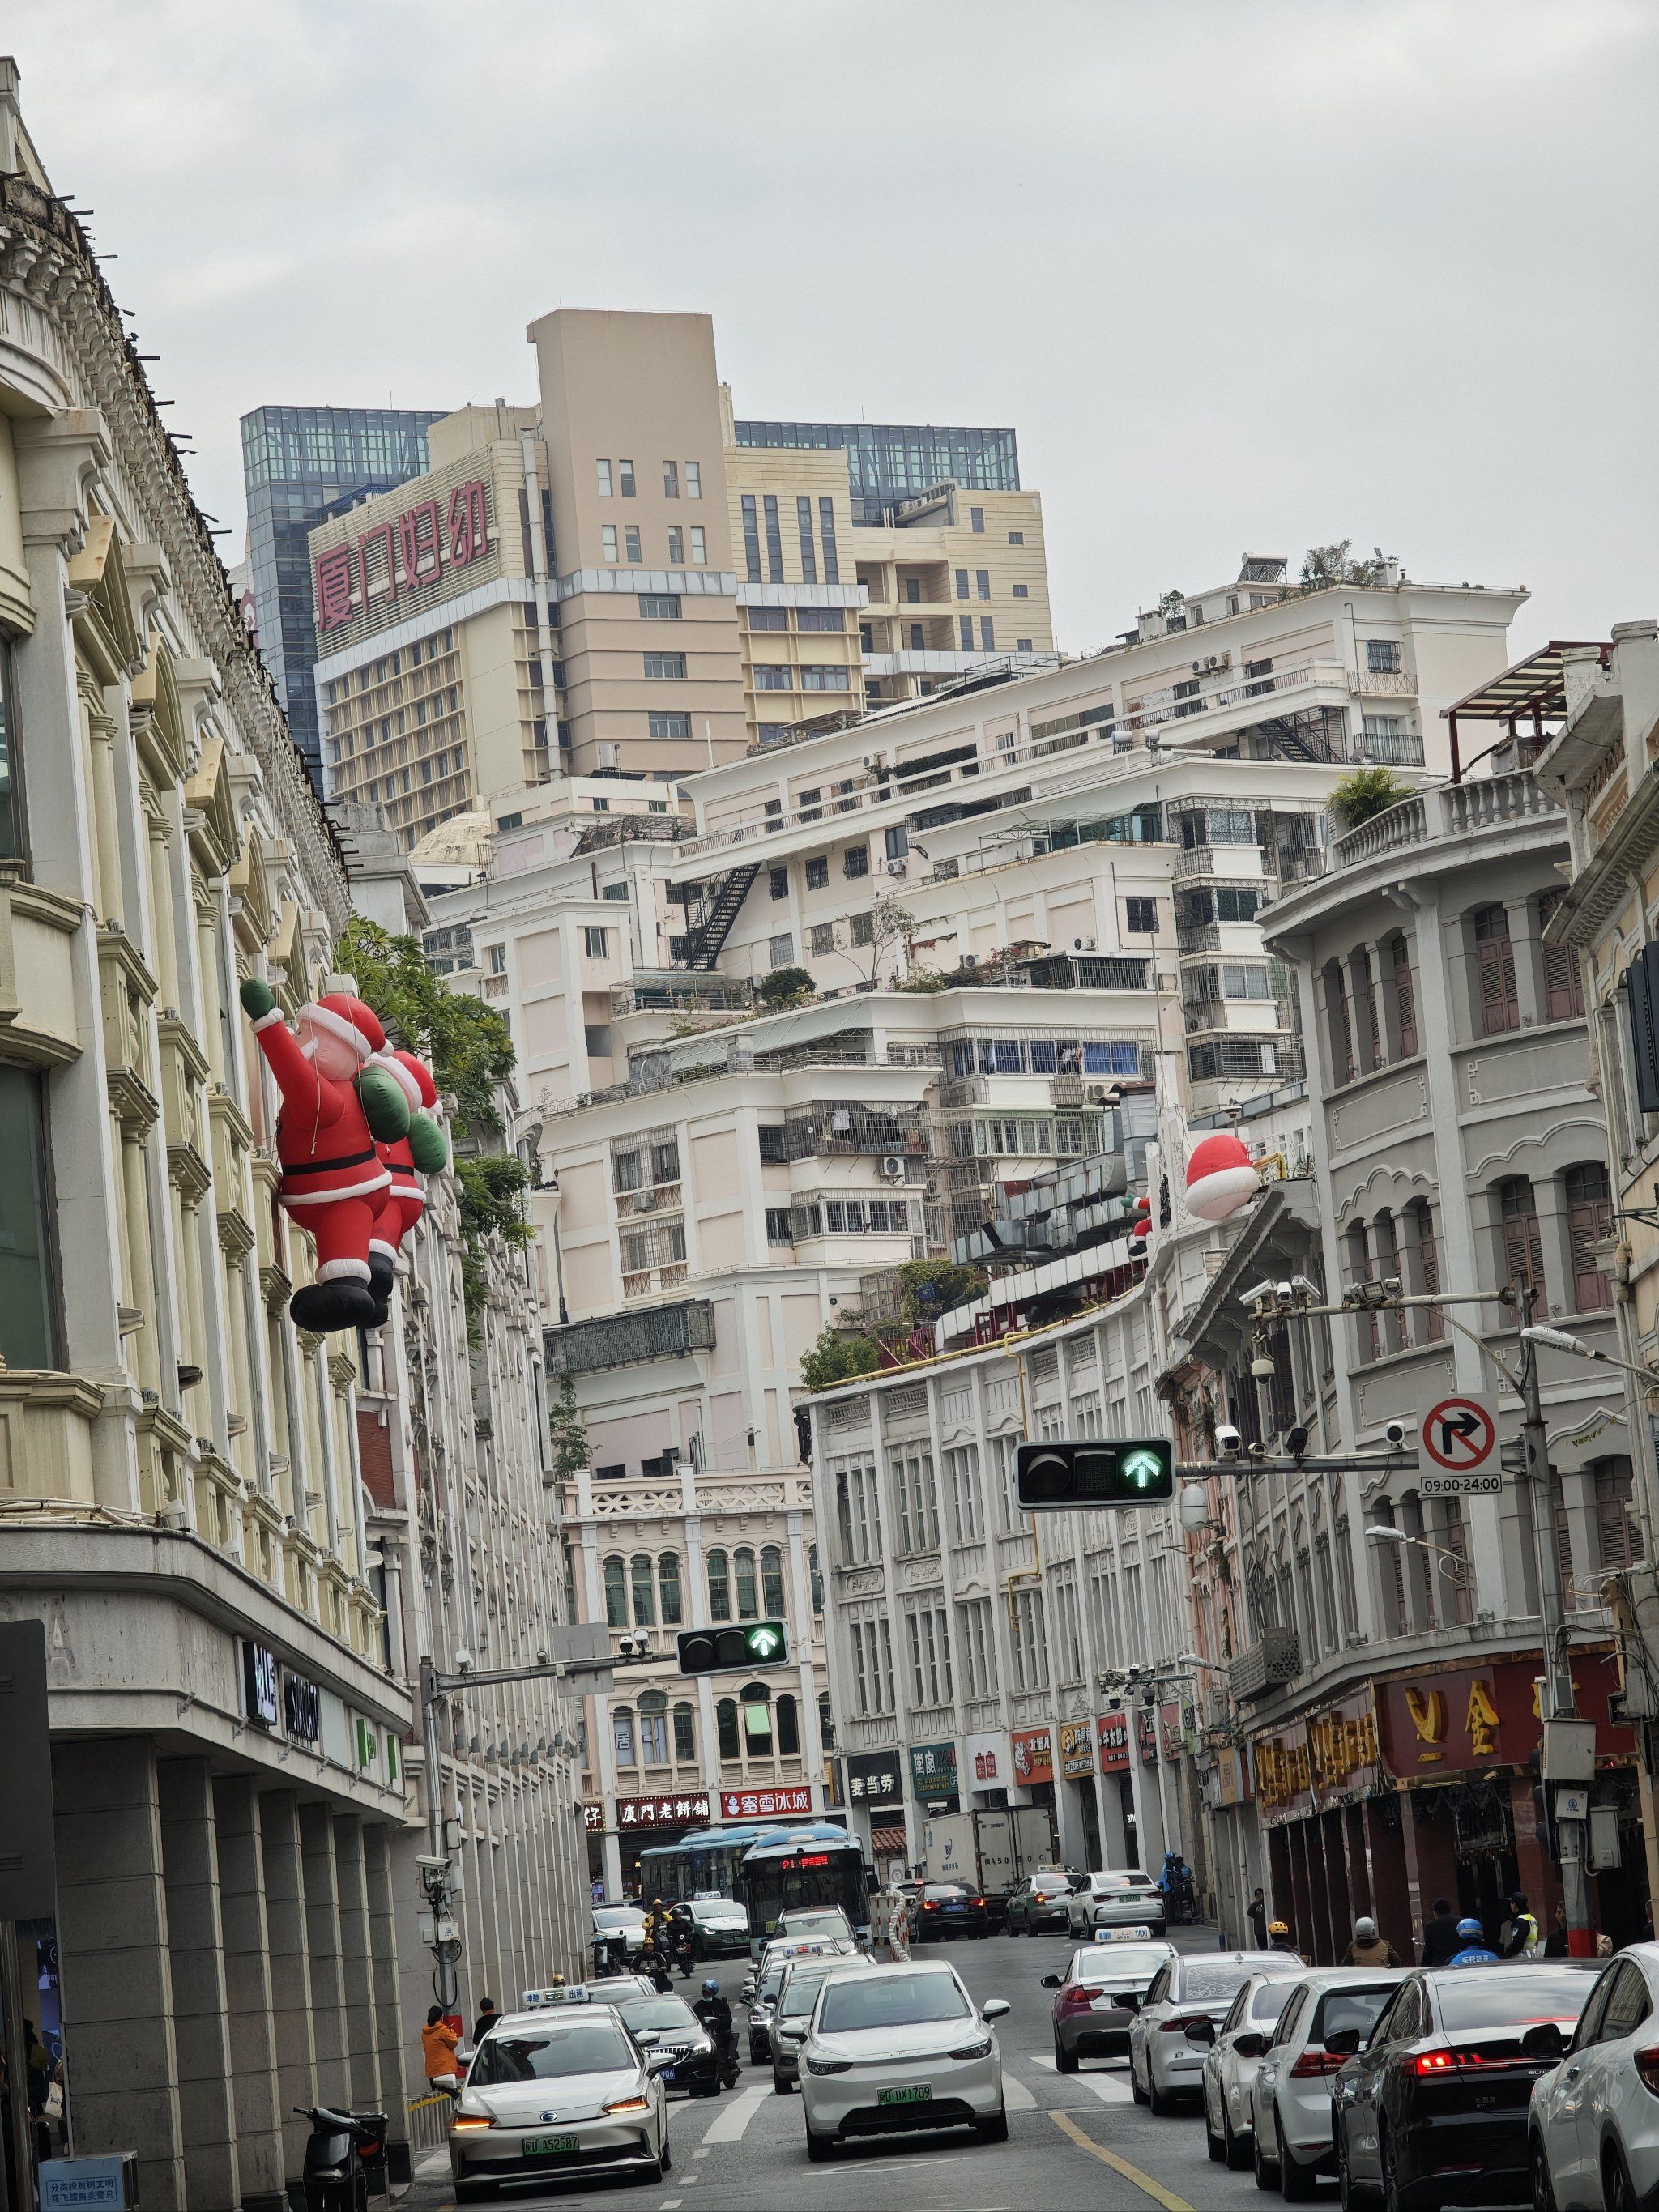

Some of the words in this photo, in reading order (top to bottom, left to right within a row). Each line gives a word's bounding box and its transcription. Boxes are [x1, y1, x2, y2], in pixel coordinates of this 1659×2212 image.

[315, 480, 488, 633] 厦门妇幼
[1425, 1478, 1499, 1492] 09:00-24:00
[615, 1732, 630, 1750] 居
[851, 1773, 894, 1797] 麦当劳
[741, 1791, 808, 1814] 蜜雪冰城
[1135, 1929, 1148, 1937] TAXI
[569, 1988, 584, 1999] 出租
[542, 2137, 578, 2152] A52587
